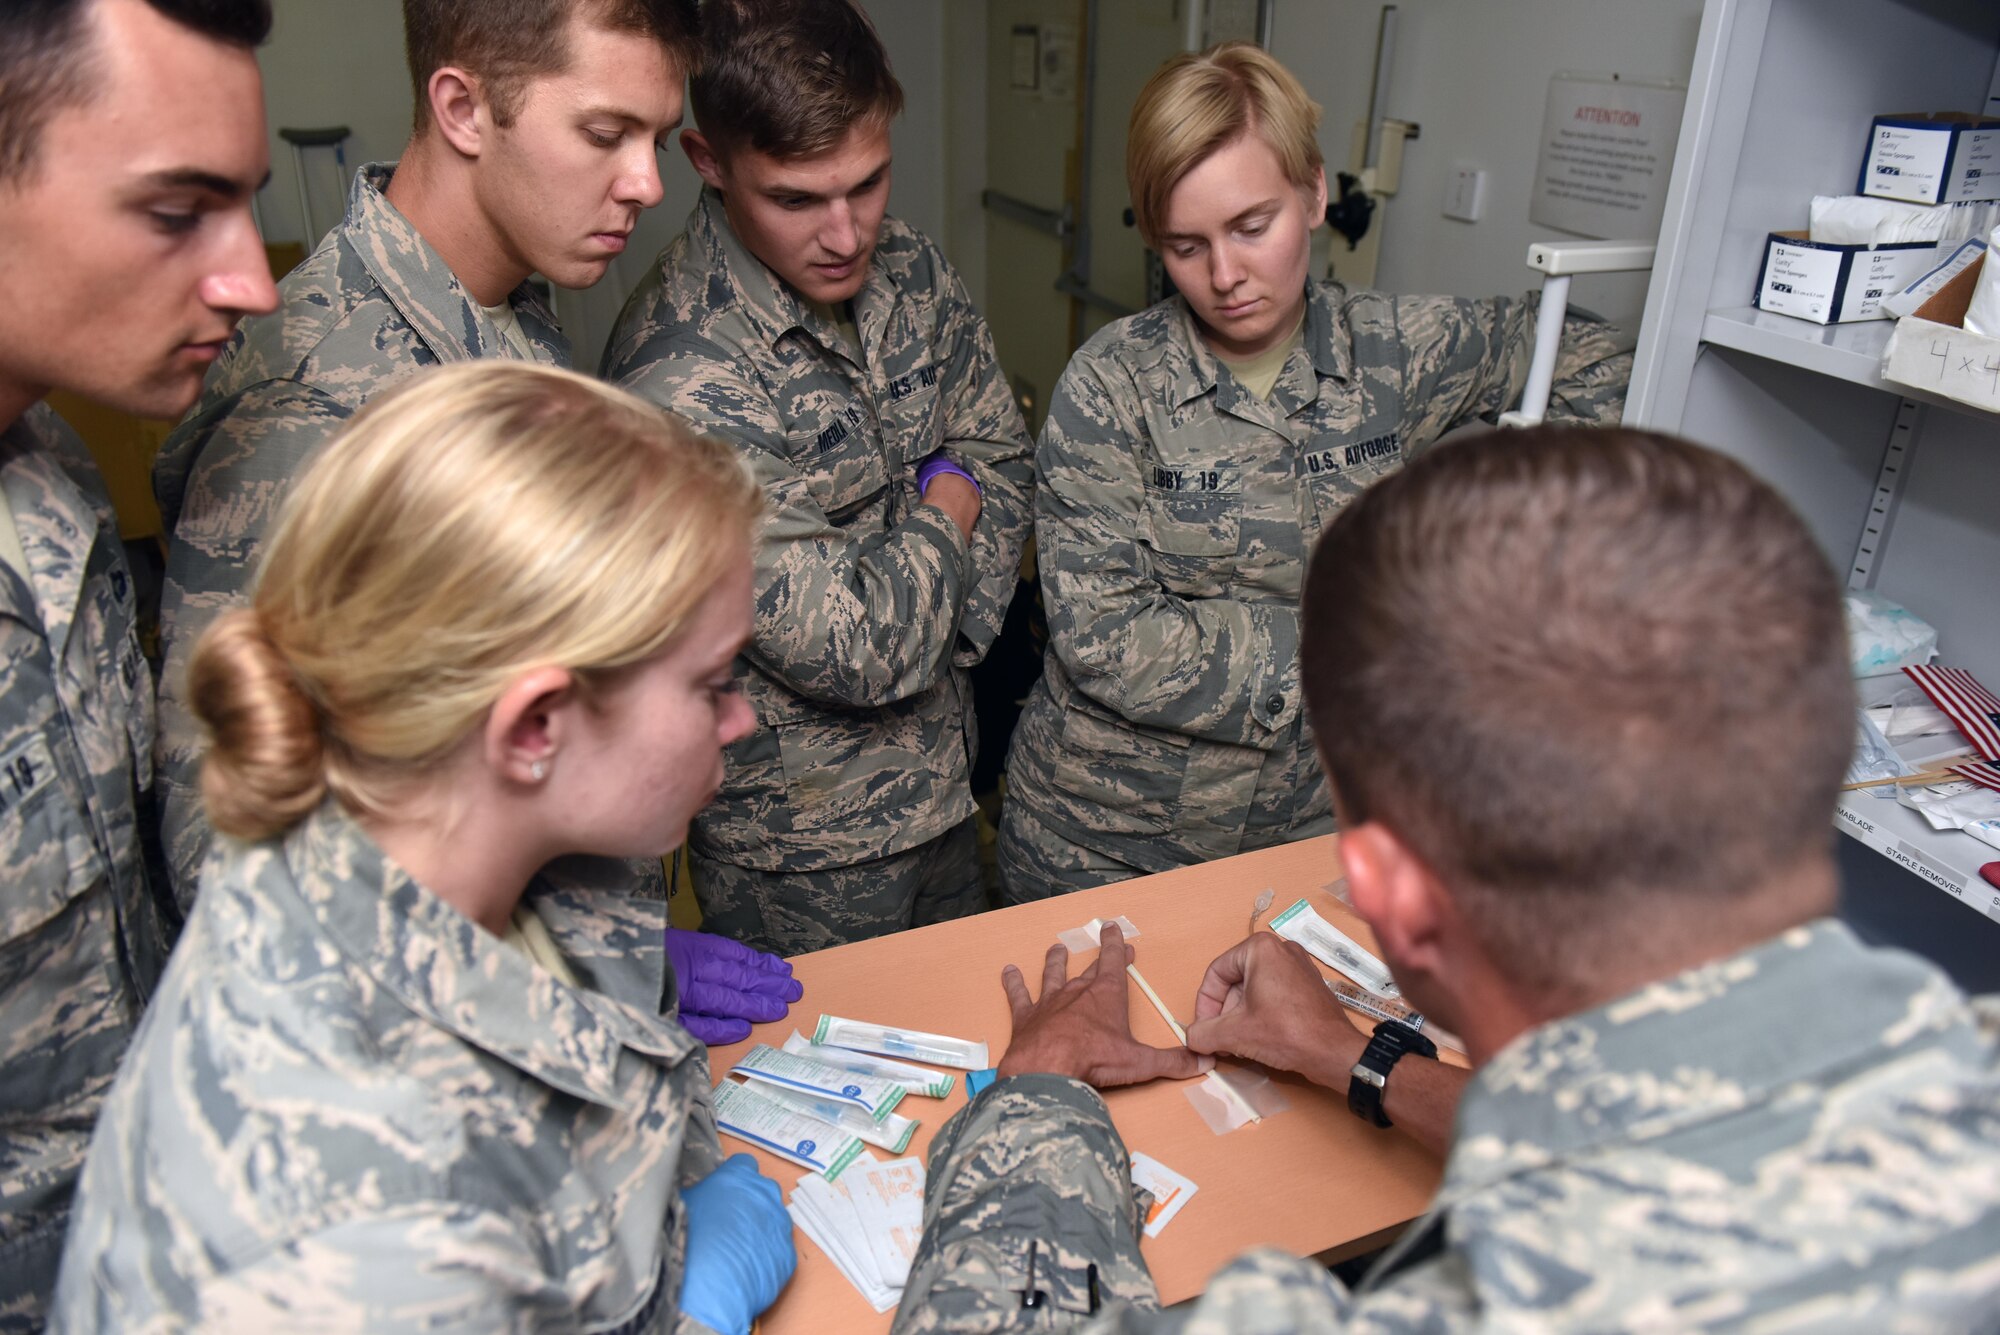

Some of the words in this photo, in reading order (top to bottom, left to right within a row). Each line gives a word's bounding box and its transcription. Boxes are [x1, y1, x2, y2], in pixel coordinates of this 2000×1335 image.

[1574, 106, 1642, 128] ATTENTION
[1930, 340, 1950, 380] 4
[1984, 355, 2000, 395] 4
[889, 377, 917, 400] U.S.
[845, 406, 861, 428] 19
[1307, 455, 1339, 473] U.S.
[1153, 466, 1183, 491] LIBBY
[1200, 470, 1218, 491] 19
[1885, 846, 1918, 871] STAPLE
[1919, 866, 1963, 896] REMOVER
[1345, 997, 1361, 1007] SODIUM
[1360, 1003, 1379, 1015] CHLORIDE
